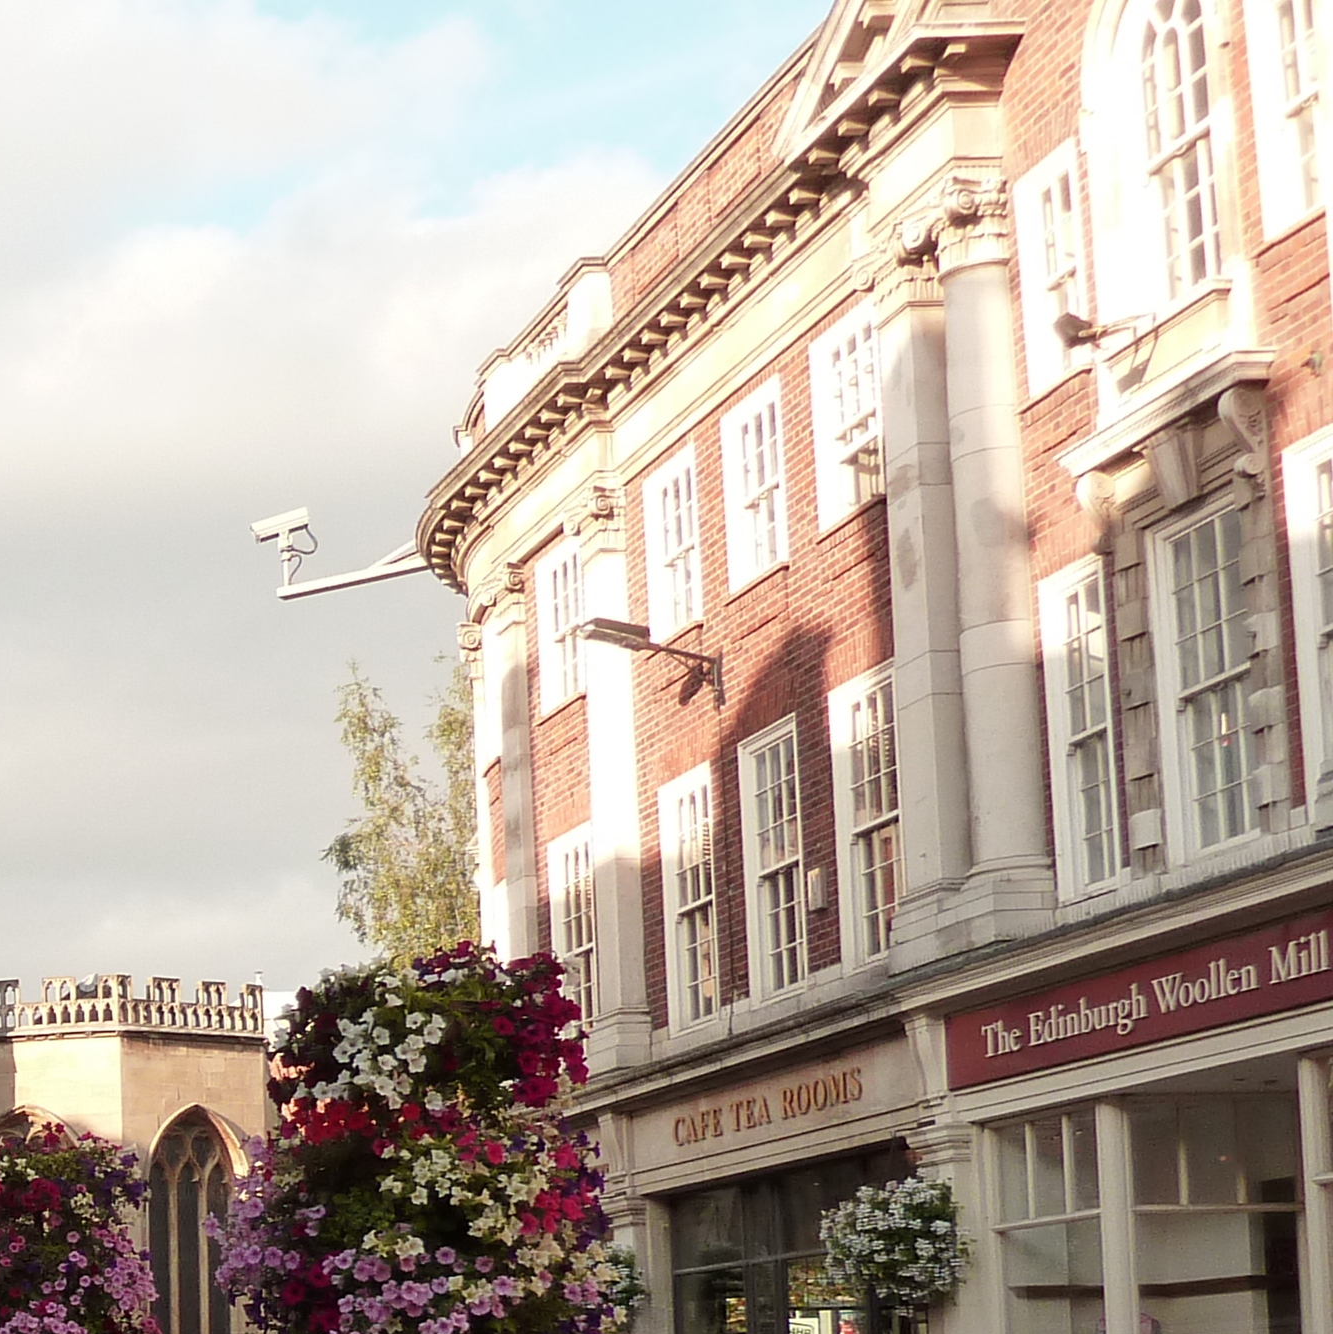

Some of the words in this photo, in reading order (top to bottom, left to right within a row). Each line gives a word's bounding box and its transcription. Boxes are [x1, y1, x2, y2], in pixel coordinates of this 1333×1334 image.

[981, 1020, 1022, 1058] The
[1027, 982, 1149, 1036] Edinburgh
[1151, 957, 1260, 1015] Woollen
[1267, 929, 1331, 986] Mill
[672, 1106, 724, 1147] CAFE
[730, 1096, 773, 1133] TEA
[781, 1066, 864, 1120] ROOMS
